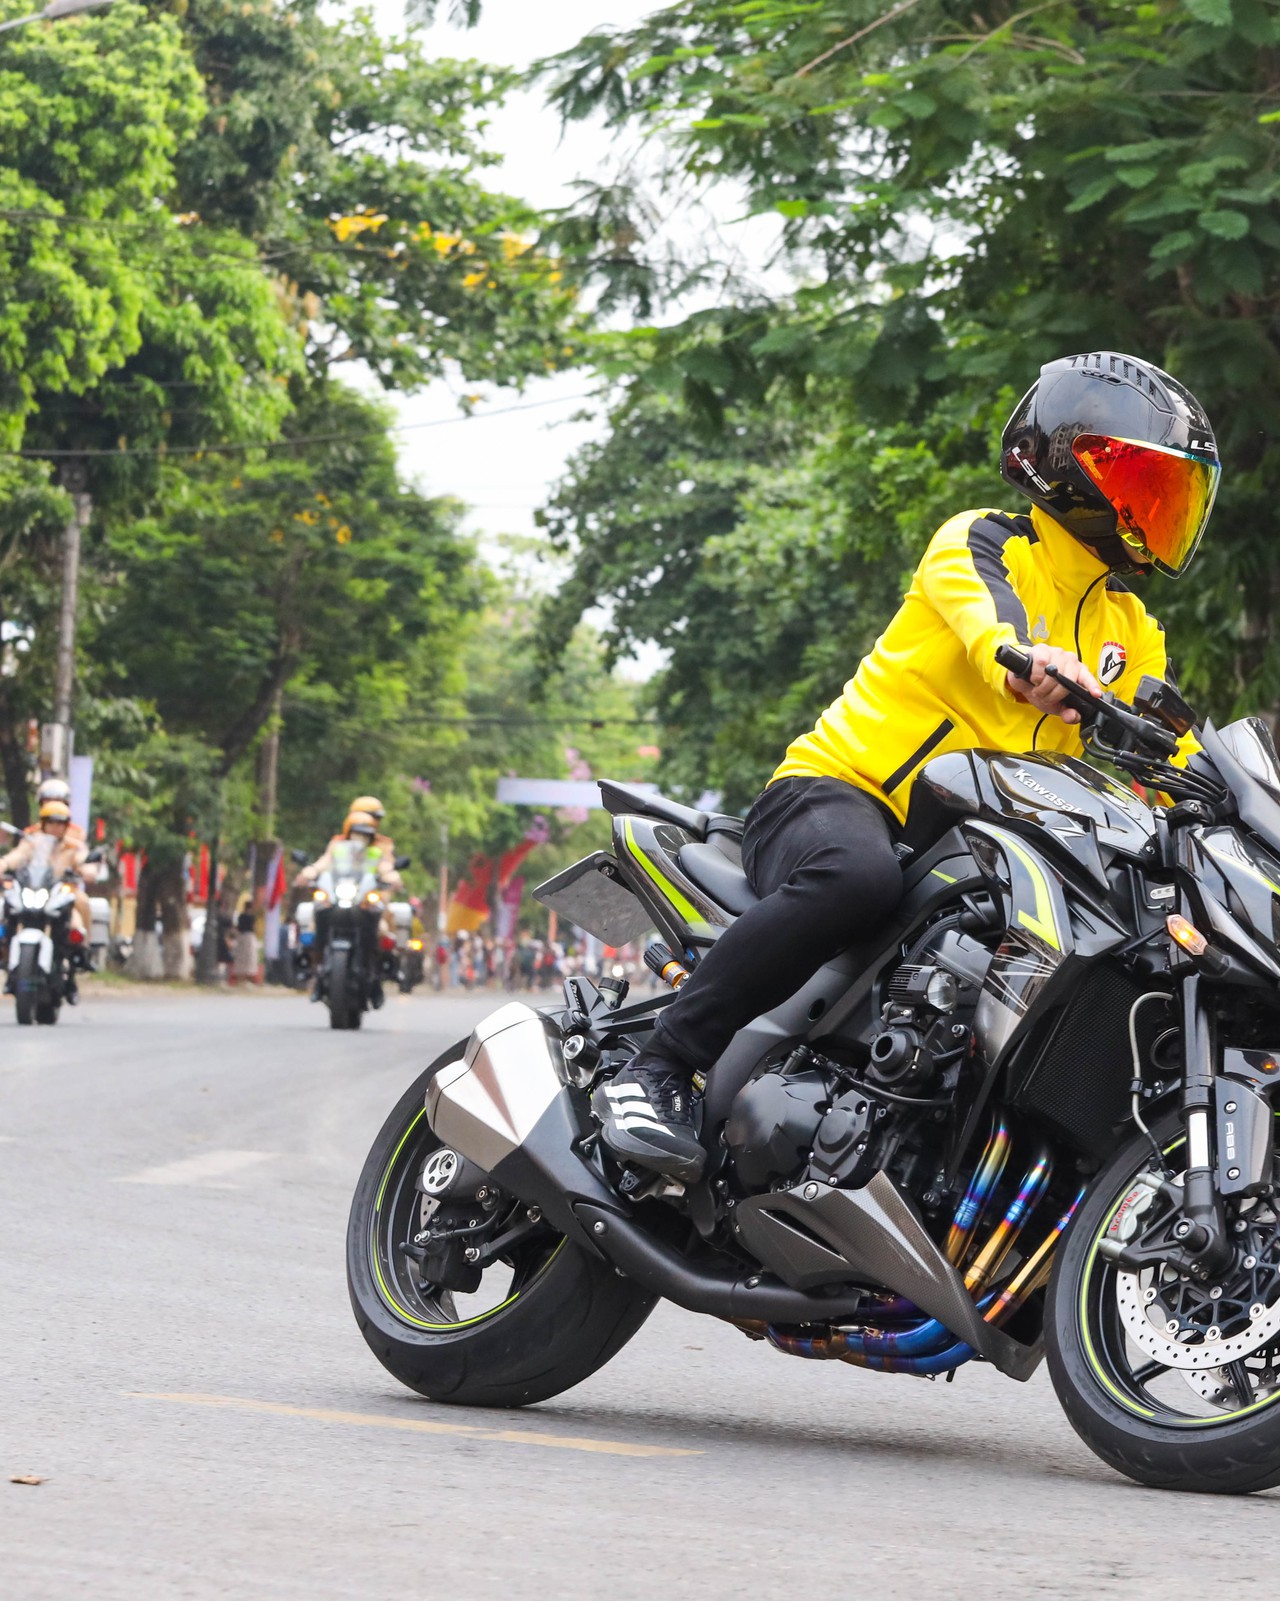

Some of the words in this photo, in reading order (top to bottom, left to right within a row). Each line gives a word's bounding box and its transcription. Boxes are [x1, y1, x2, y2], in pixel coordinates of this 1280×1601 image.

[1191, 440, 1216, 453] LS
[1011, 446, 1052, 494] LS2
[1014, 769, 1084, 815] Kawasak
[1225, 1122, 1235, 1160] ABS
[1110, 1191, 1139, 1232] brembo
